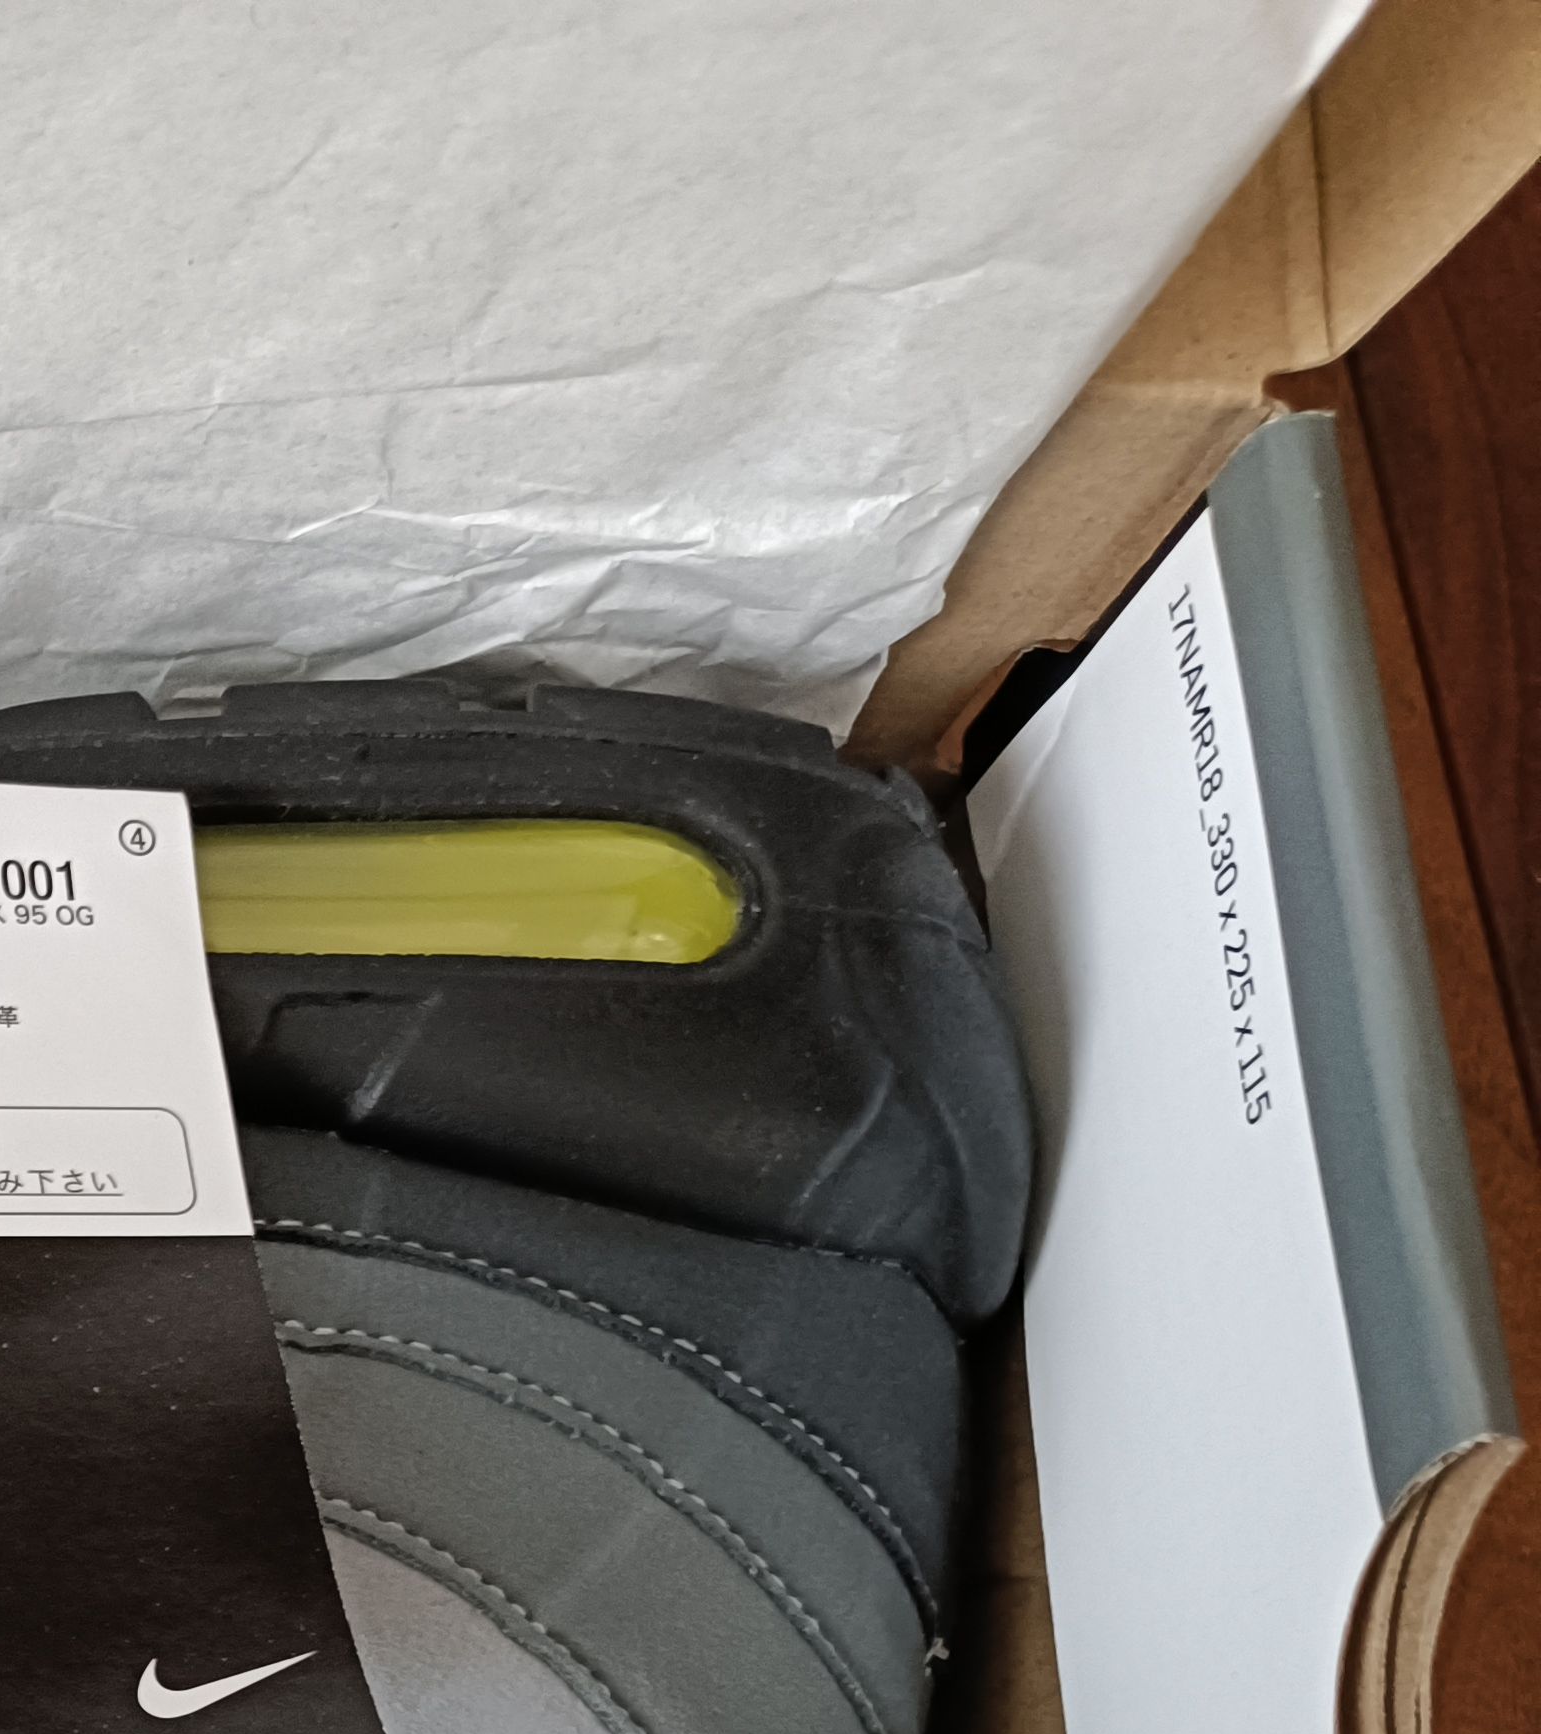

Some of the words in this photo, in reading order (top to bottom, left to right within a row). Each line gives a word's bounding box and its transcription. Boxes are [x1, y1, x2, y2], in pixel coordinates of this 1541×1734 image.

[0, 859, 76, 901] 001
[13, 904, 48, 926] 95
[55, 905, 95, 927] OG
[1224, 929, 1255, 1011] 225
[1237, 1045, 1271, 1125] 115
